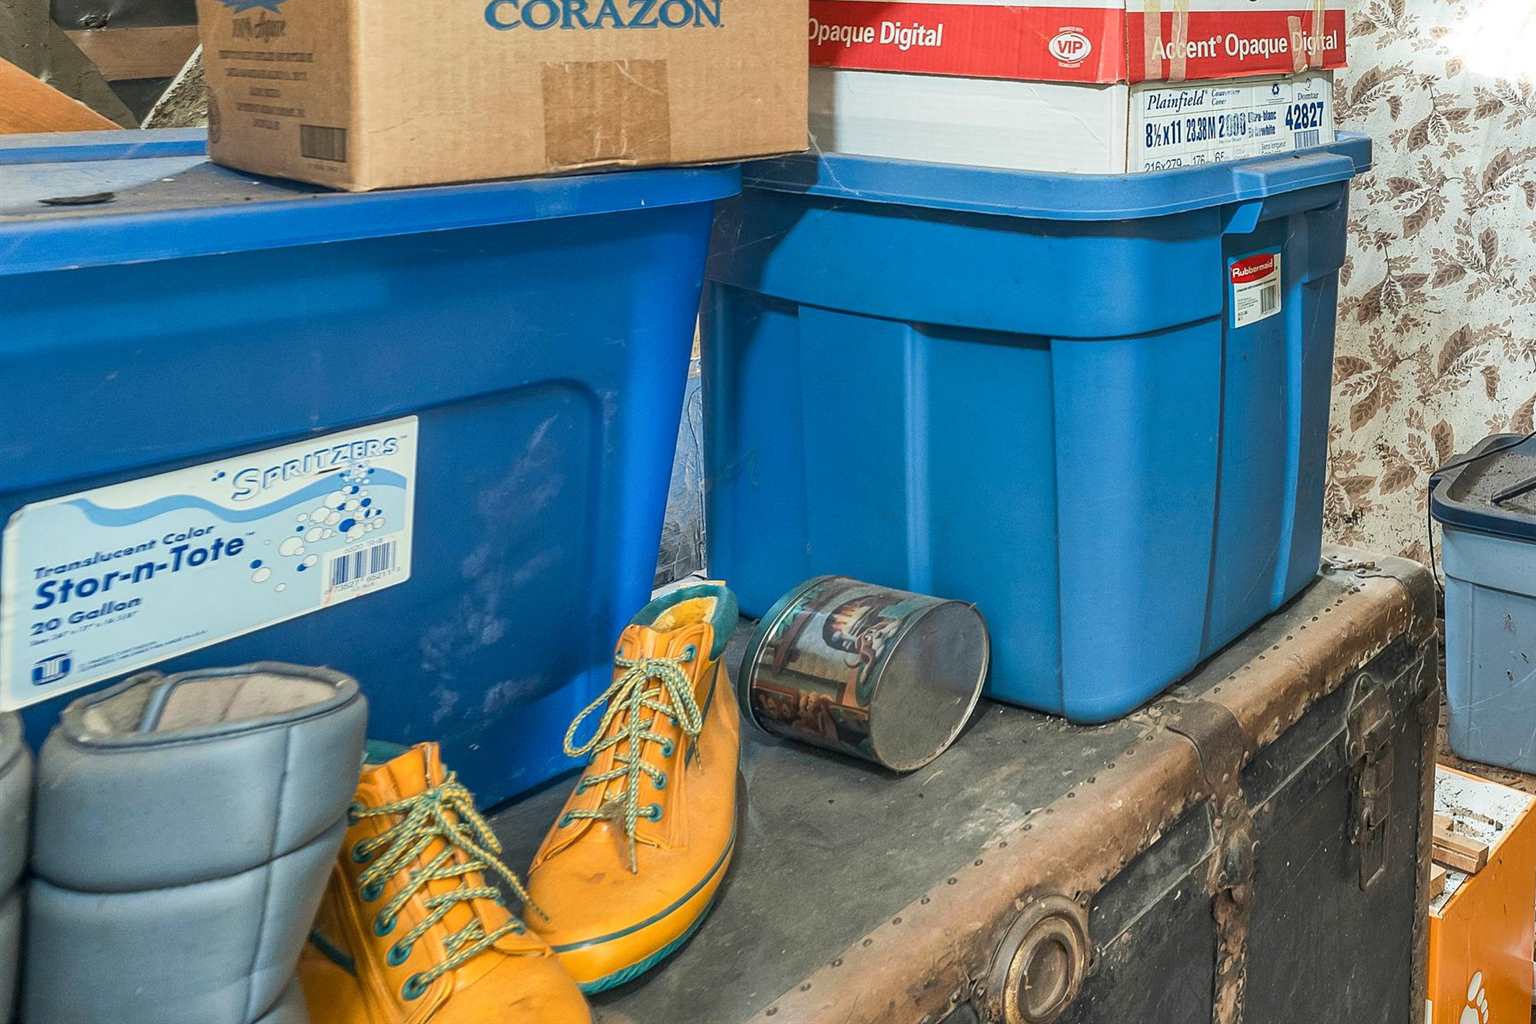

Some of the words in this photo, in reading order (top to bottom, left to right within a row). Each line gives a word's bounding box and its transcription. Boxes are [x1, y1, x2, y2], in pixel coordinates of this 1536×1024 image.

[809, 18, 875, 48] Opaque
[880, 20, 944, 52] Digital
[1058, 40, 1083, 54] VIP
[1225, 33, 1288, 60] Opaque
[1292, 29, 1338, 56] Digital
[1285, 102, 1324, 131] 42827
[1232, 257, 1273, 278] Rubbermaid
[231, 437, 399, 502] SPRITZERS
[33, 539, 157, 580] Translucent
[162, 525, 216, 545] Color
[32, 536, 245, 611] Stor-n-Tote
[30, 617, 62, 636] 20
[68, 596, 142, 625] Gallon
